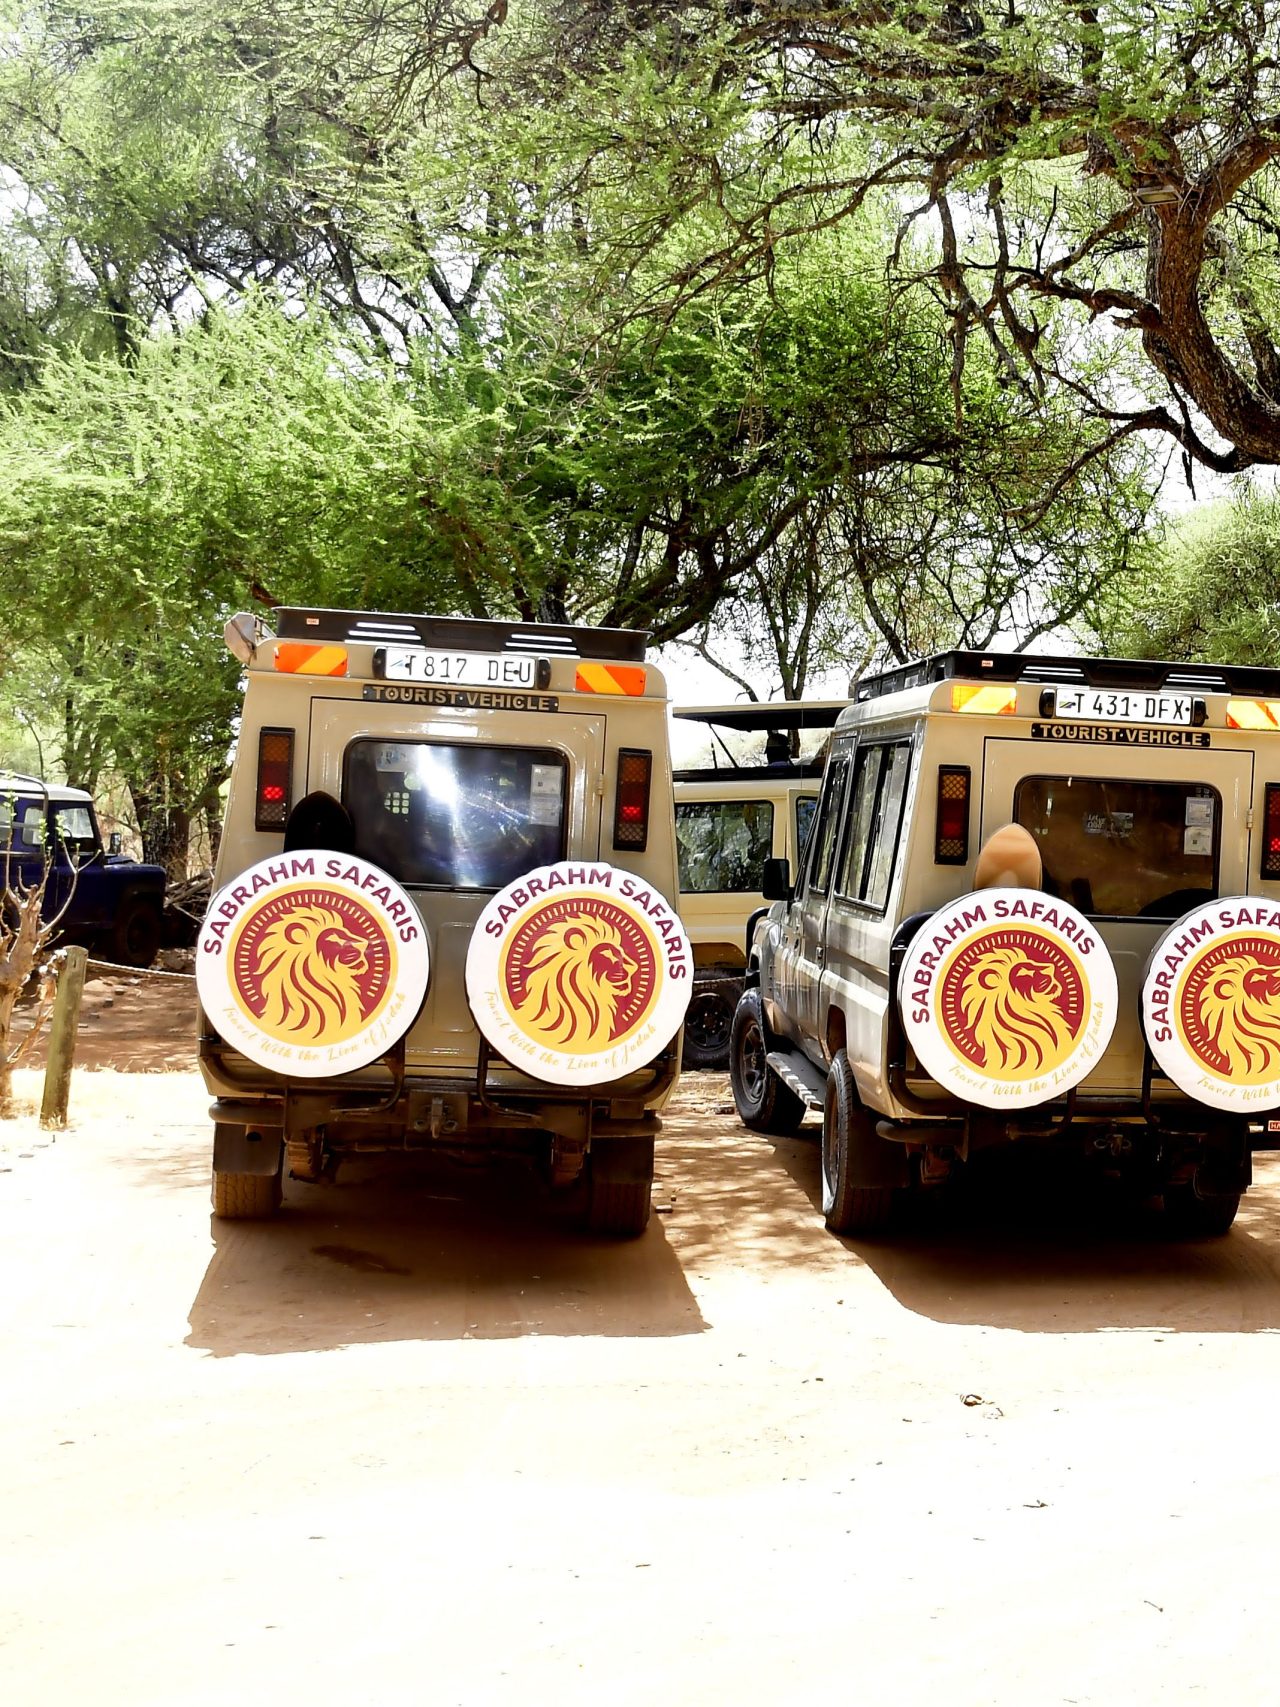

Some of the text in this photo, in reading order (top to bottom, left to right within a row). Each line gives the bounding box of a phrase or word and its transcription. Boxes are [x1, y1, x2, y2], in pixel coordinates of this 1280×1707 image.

[406, 655, 531, 683] T 817 DEU
[372, 686, 550, 711] TOURIST VEHICLE
[1074, 693, 1184, 720] T 431 DFX
[1040, 724, 1203, 746] TOURIST VEHICLE
[204, 858, 418, 955] SABRAHM SAFARIS
[485, 868, 686, 980] SABRAHM SAFARIS
[912, 899, 1095, 1024] SABRAHM SAFARIS
[1151, 919, 1215, 1043] SABRAHM
[1028, 1081, 1048, 1093] the
